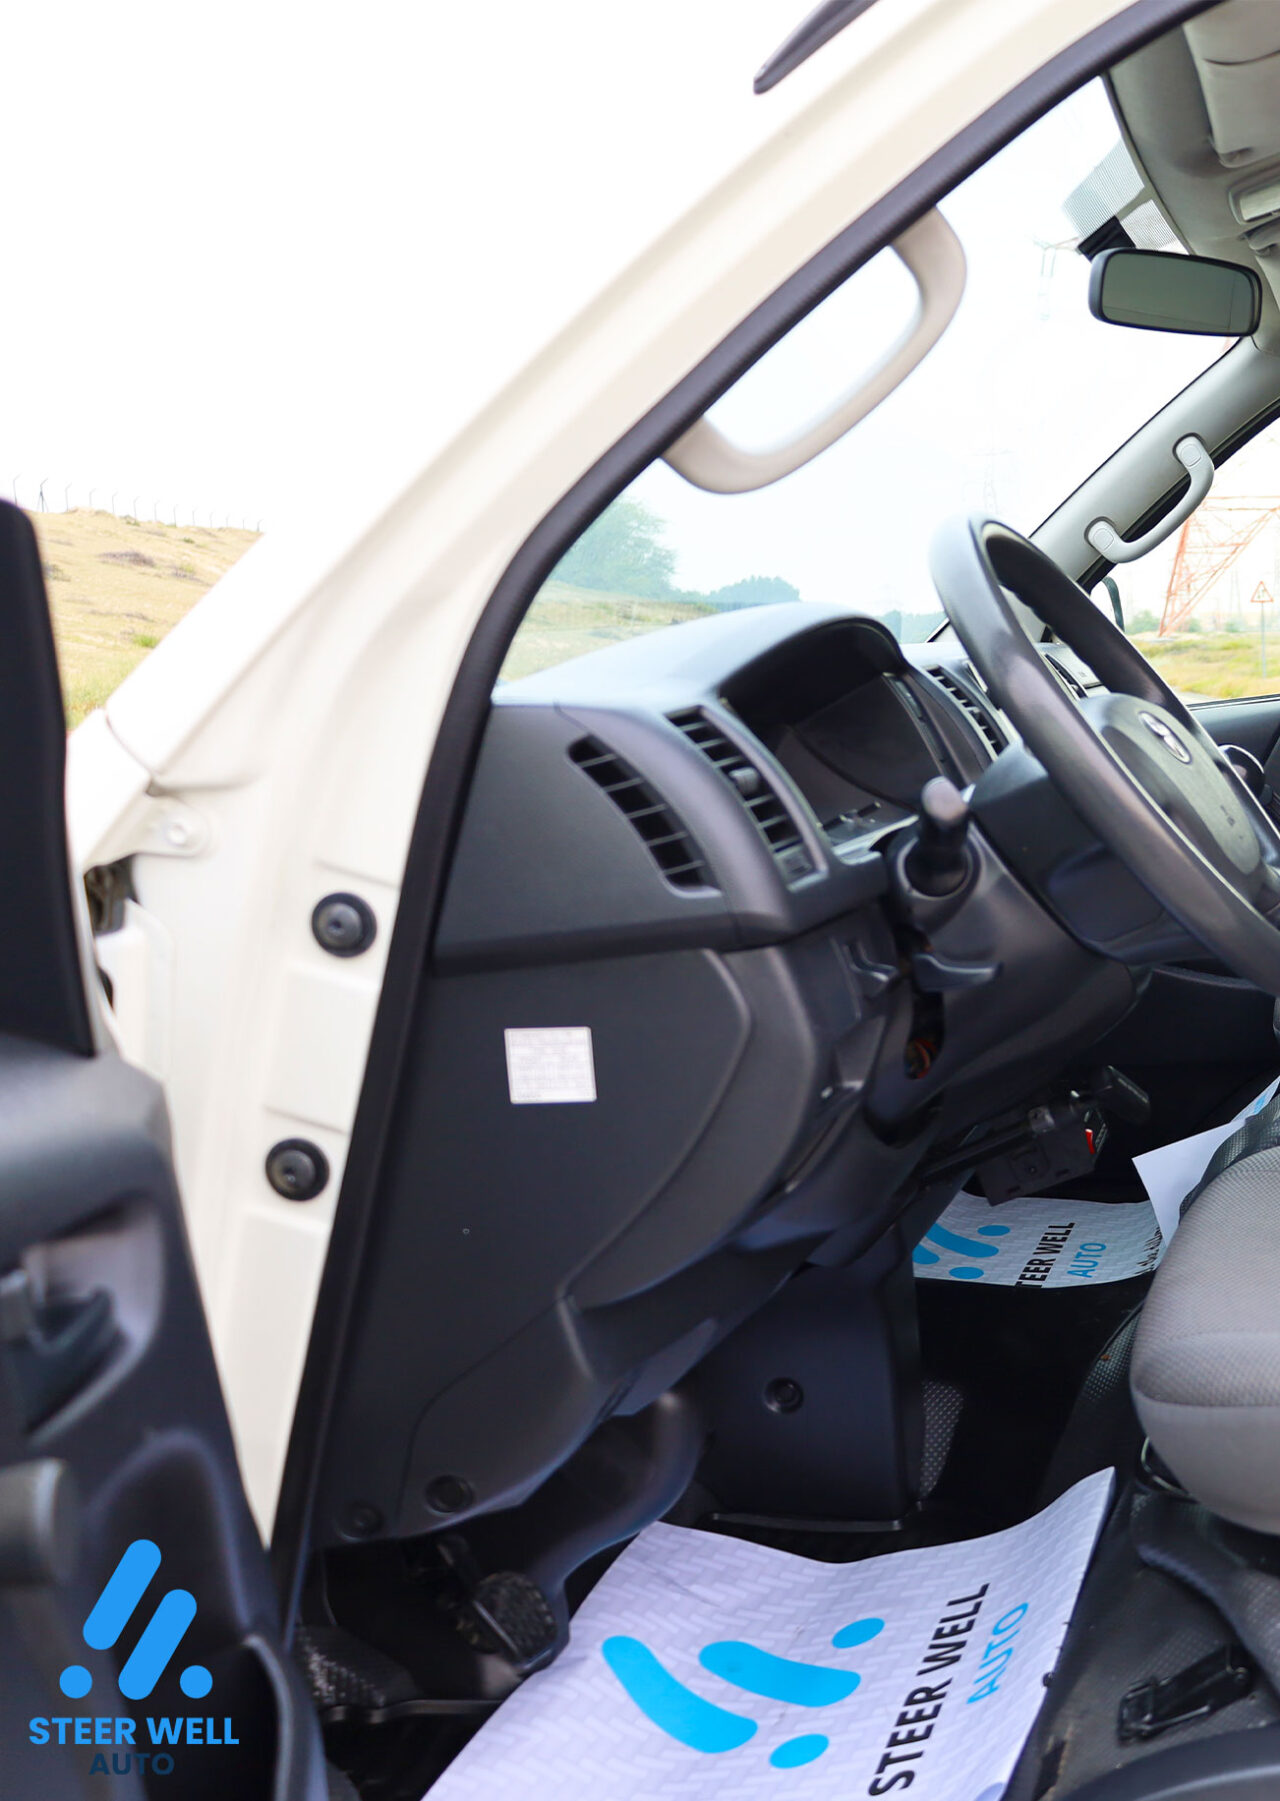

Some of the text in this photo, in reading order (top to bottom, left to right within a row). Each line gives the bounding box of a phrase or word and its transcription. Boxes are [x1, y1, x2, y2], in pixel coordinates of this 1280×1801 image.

[1015, 1222, 1076, 1288] TEER WELL
[1067, 1242, 1107, 1278] AUTO
[868, 1582, 990, 1796] STEER WELL
[966, 1602, 1029, 1704] AUTO
